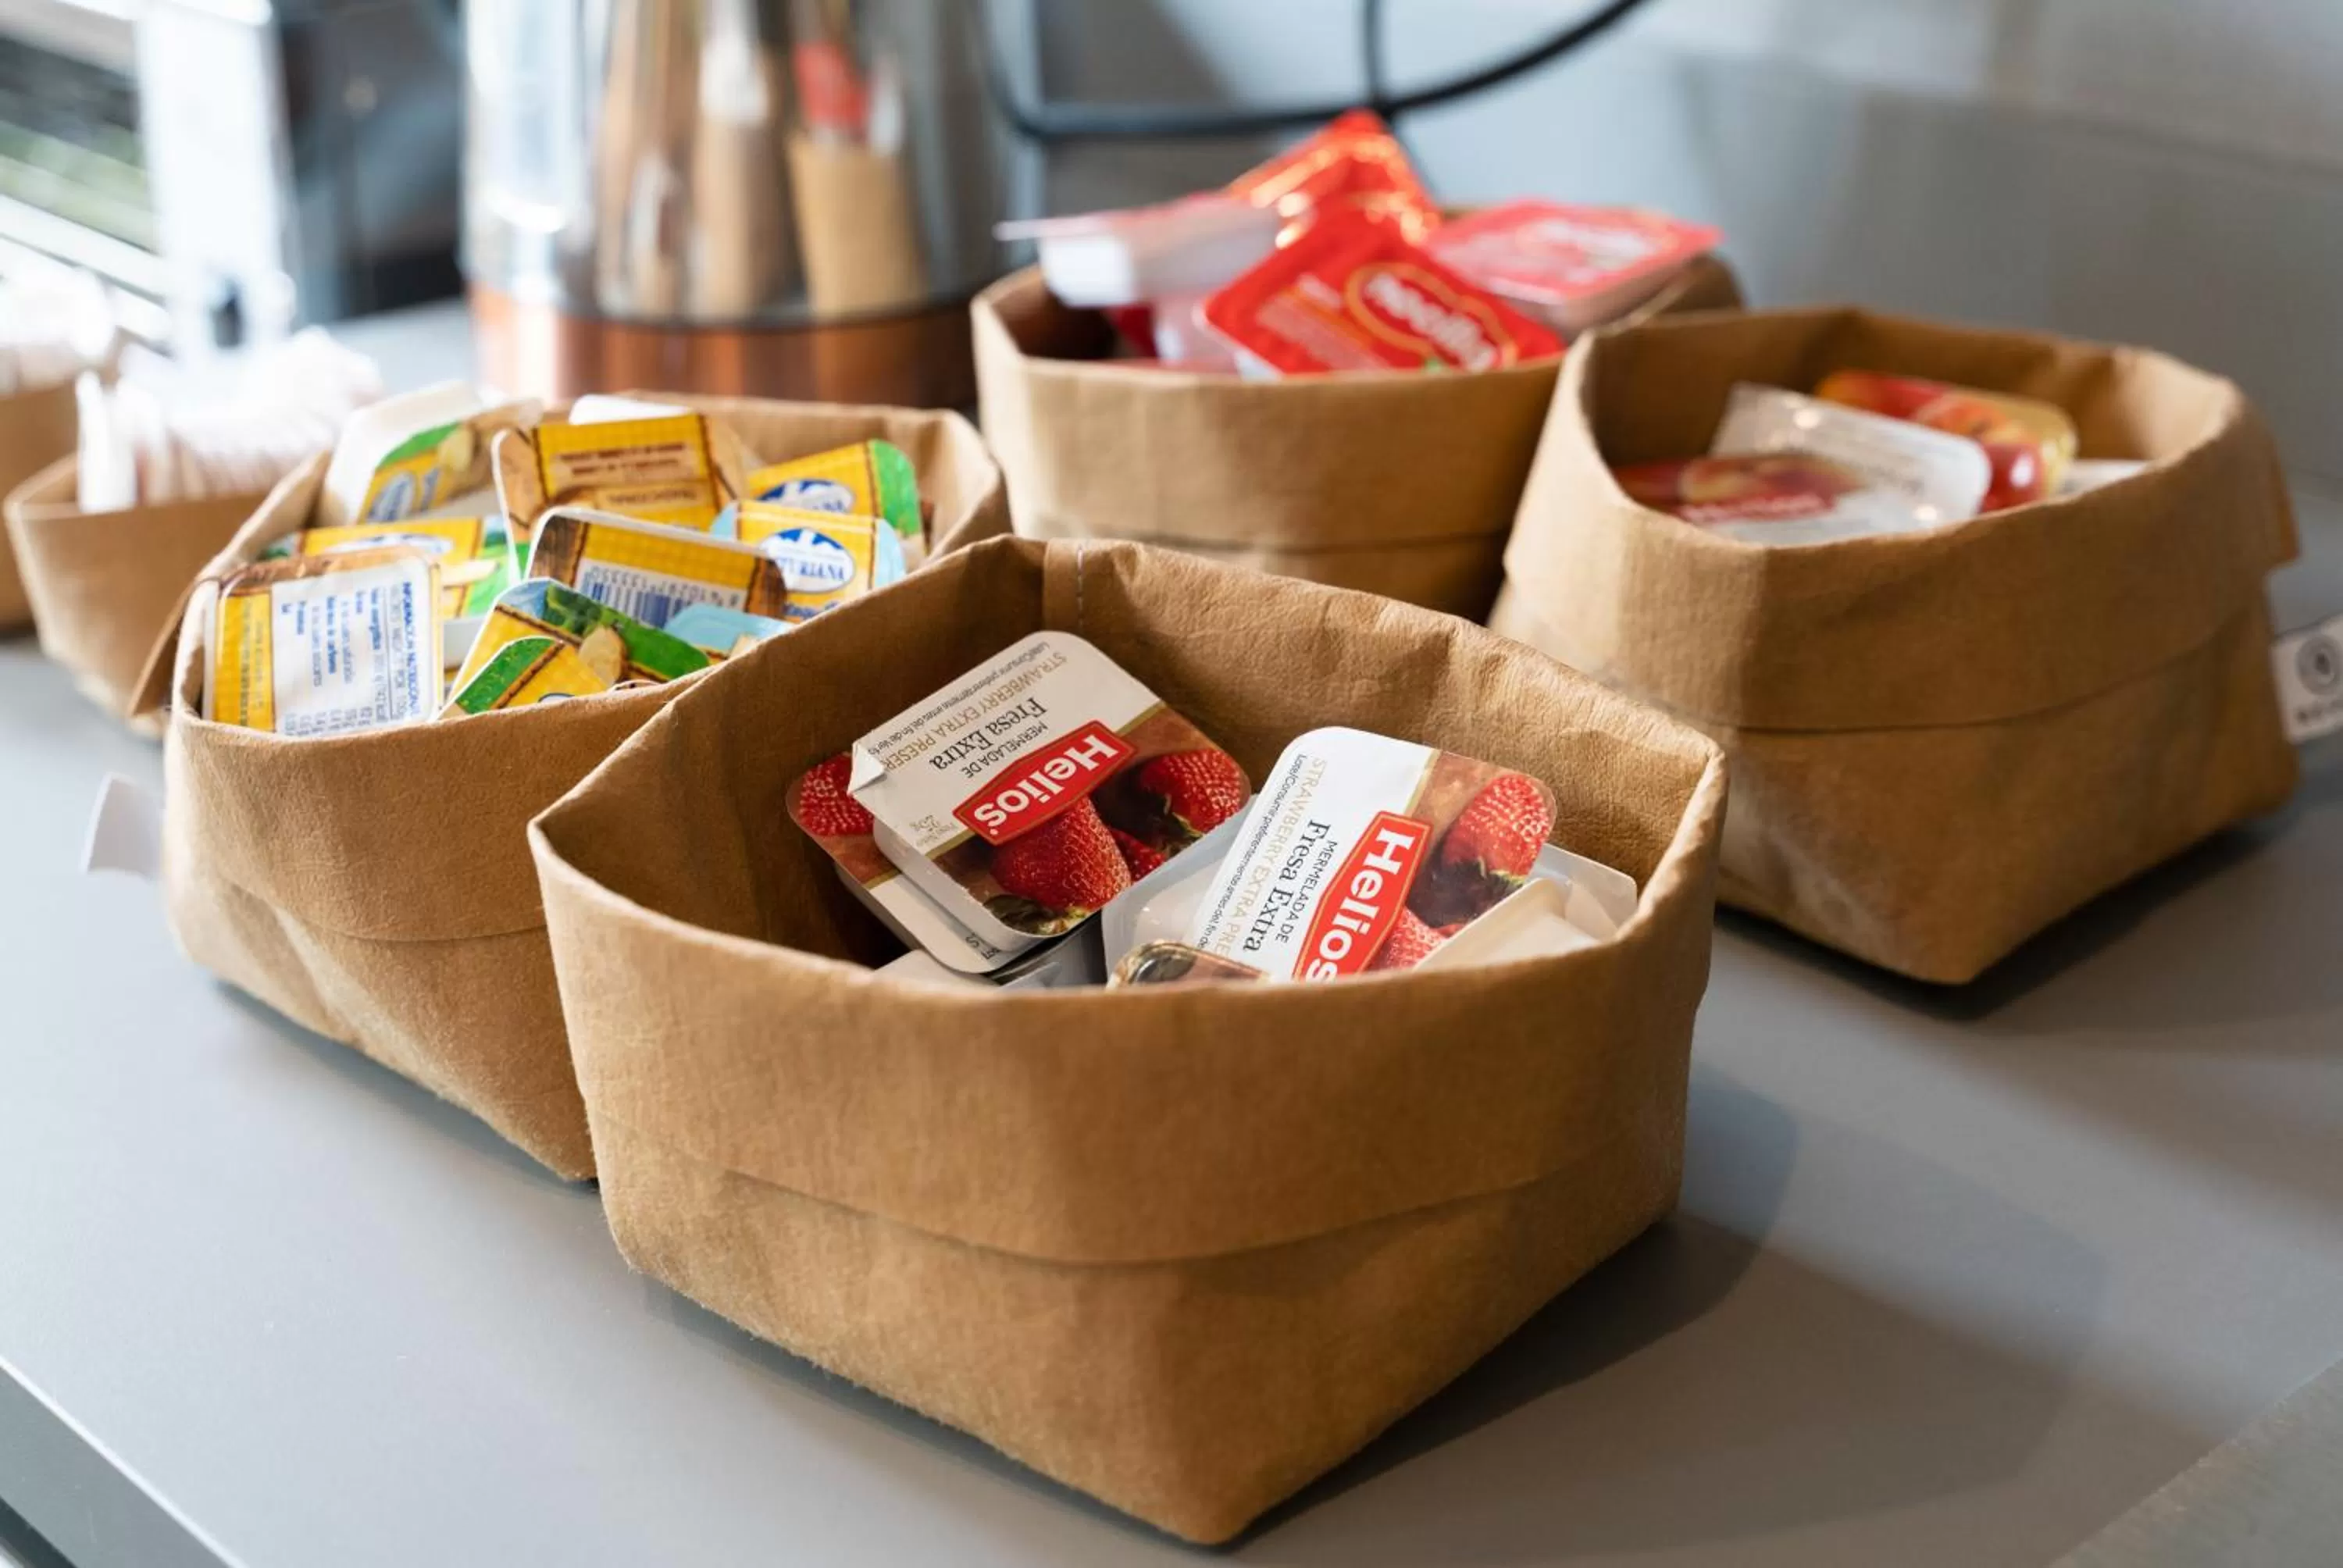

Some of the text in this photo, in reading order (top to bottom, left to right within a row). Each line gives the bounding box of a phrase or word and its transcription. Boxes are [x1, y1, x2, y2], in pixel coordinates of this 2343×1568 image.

[879, 651, 1068, 772] STRAWBERRY EXTRA PRESER
[929, 697, 1048, 770] Fresa Extra
[961, 721, 1049, 779] MERMELADA DE
[974, 734, 1118, 828] Helios
[1214, 757, 1327, 956] STRAWBERRY EXTRA PRE
[1243, 820, 1332, 952] Fresa Extra
[1275, 840, 1338, 944] MERMELADA DE
[1305, 828, 1415, 983] Helios
